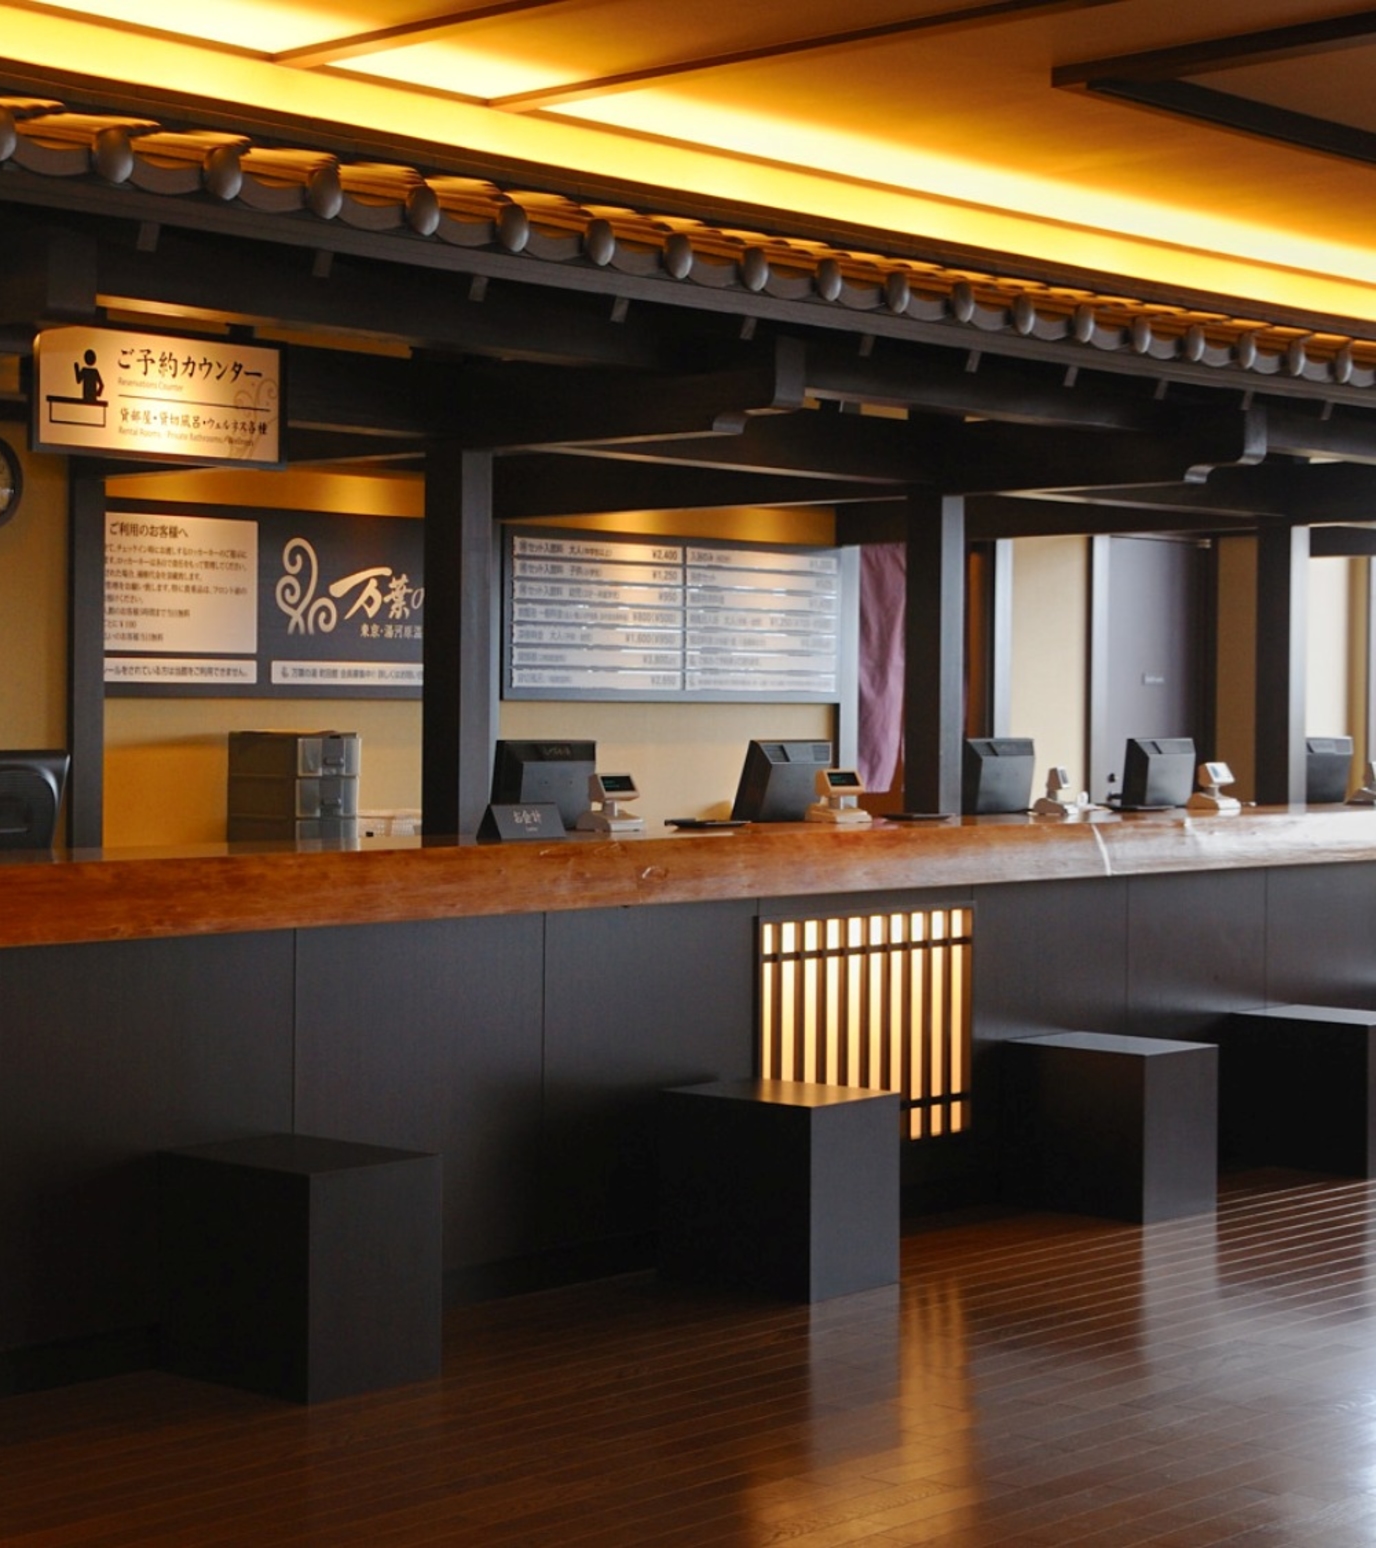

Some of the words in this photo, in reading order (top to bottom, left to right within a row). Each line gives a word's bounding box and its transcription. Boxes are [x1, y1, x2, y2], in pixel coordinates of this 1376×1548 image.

[117, 348, 263, 383] ご予約カウンター
[110, 521, 189, 539] ご利用のお客様へ
[652, 549, 678, 561] ¥2,400
